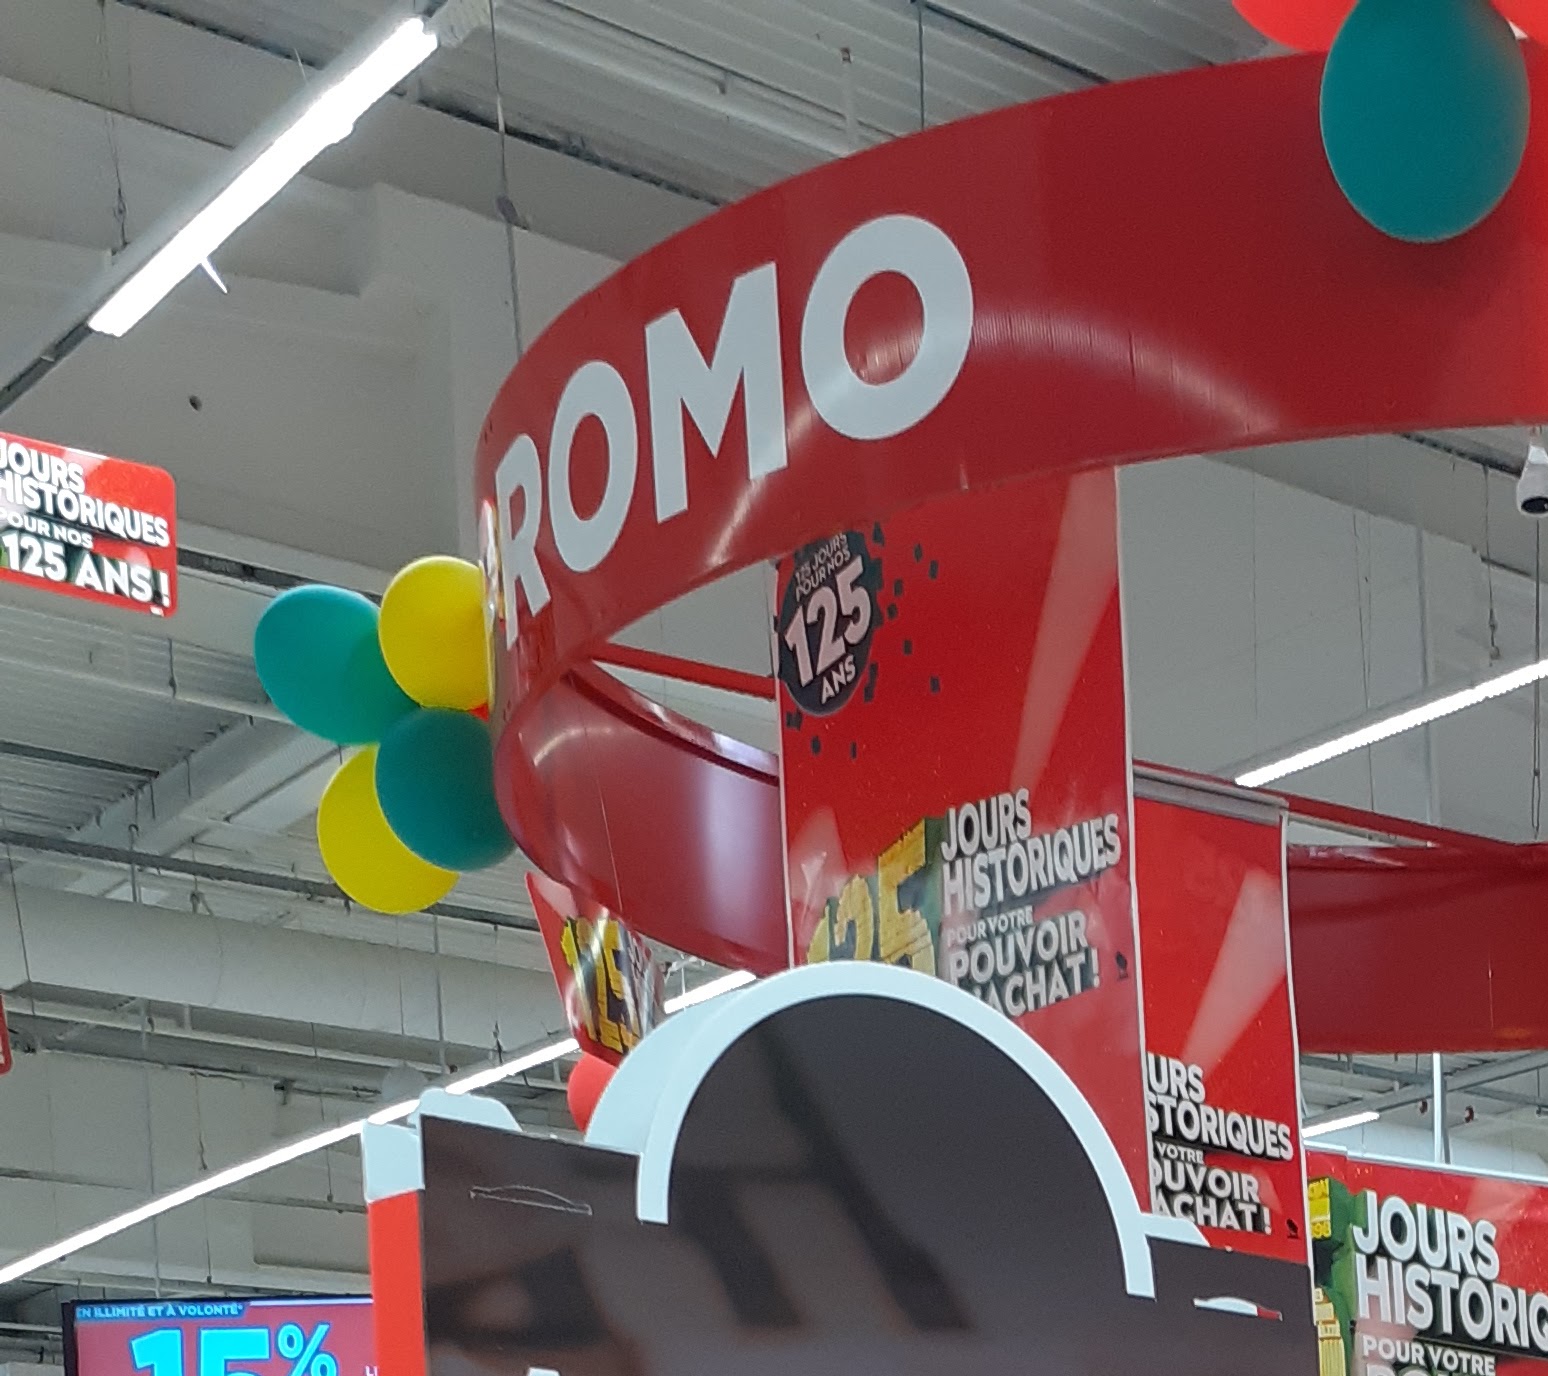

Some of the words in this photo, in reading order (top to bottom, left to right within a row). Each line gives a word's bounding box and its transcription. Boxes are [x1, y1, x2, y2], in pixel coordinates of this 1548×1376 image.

[481, 214, 974, 655] ROMO
[0, 470, 171, 548] HISTORIQUES
[54, 525, 94, 549] NOS
[827, 549, 851, 577] NOS
[784, 554, 871, 687] 125
[821, 653, 857, 704] ANS
[941, 787, 1032, 861] JOURS
[941, 813, 1122, 916] HISTORIQUES
[947, 915, 987, 946] POUR
[988, 905, 1033, 933] VOTRE
[949, 910, 1089, 985] POUVOIR
[1156, 1142, 1204, 1165] VOTRE
[1352, 1190, 1500, 1280] JOURS
[1362, 1335, 1426, 1368] POUR
